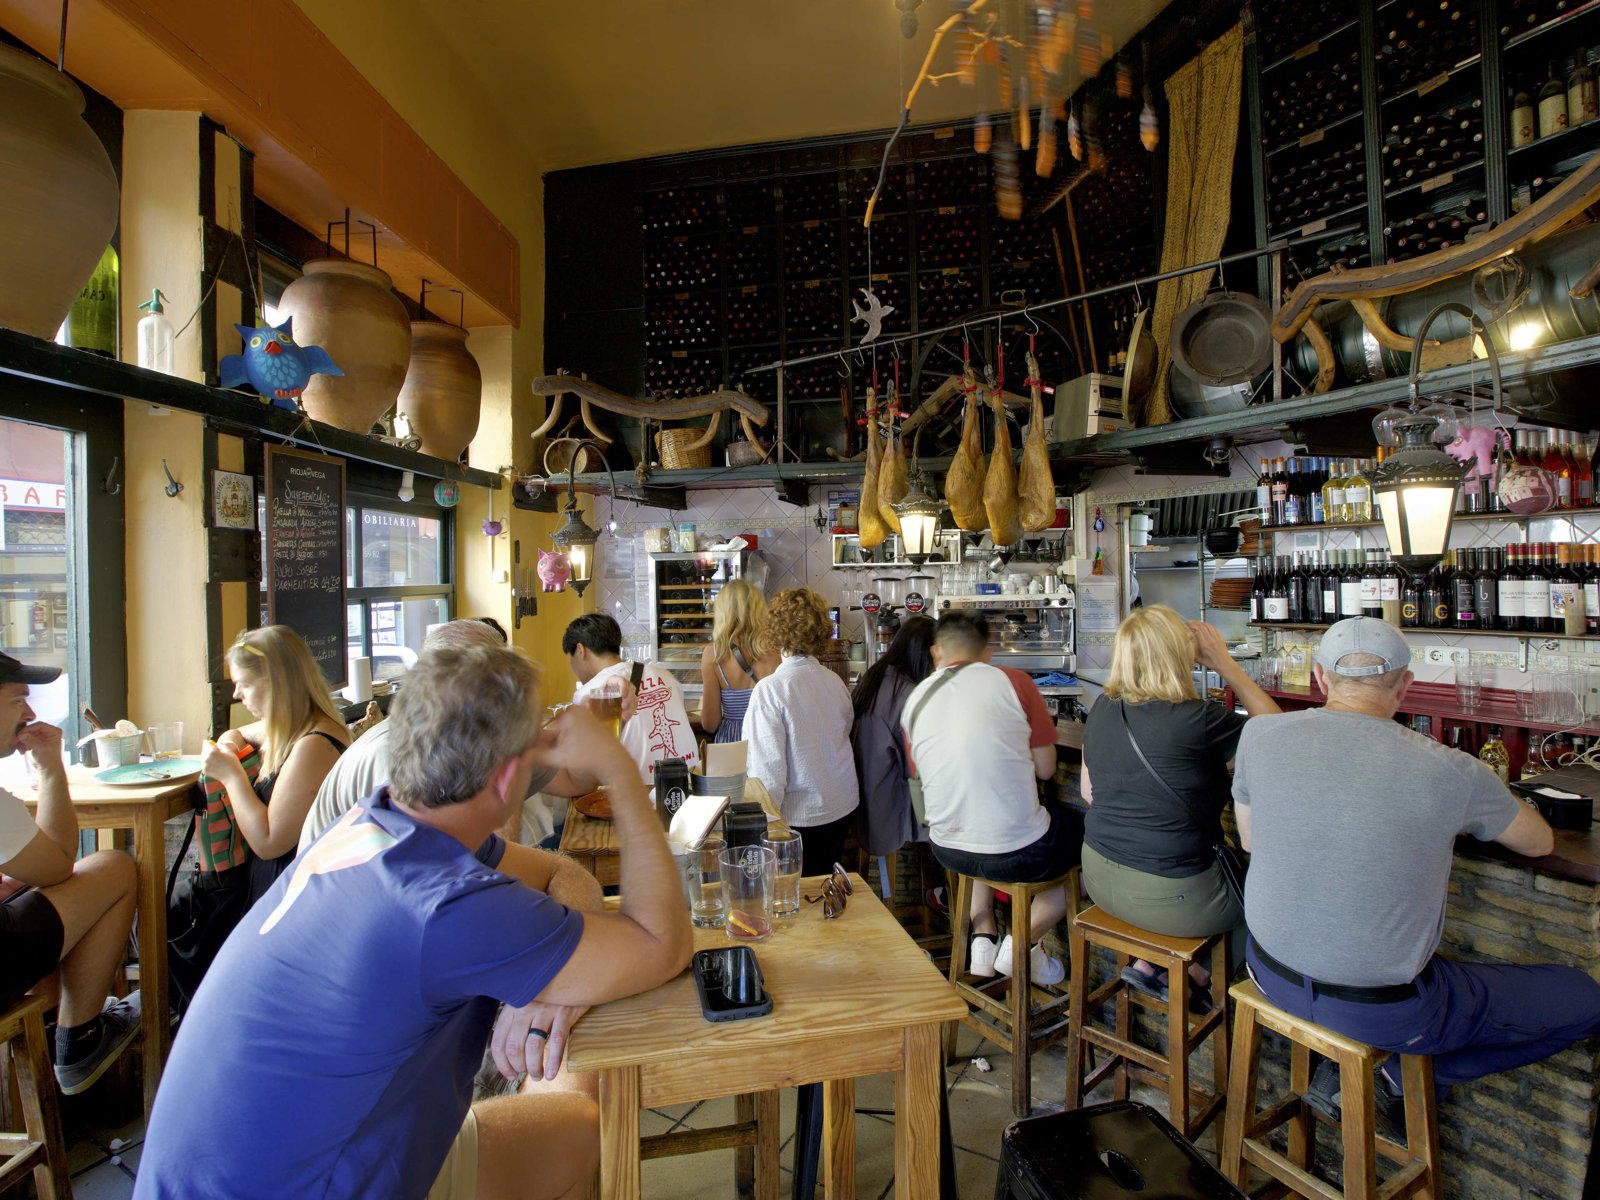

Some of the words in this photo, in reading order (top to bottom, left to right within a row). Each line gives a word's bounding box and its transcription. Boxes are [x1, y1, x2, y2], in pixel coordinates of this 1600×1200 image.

[312, 471, 326, 479] VEGA
[347, 513, 417, 528] NOBILIARIA
[640, 677, 665, 691] ZZA
